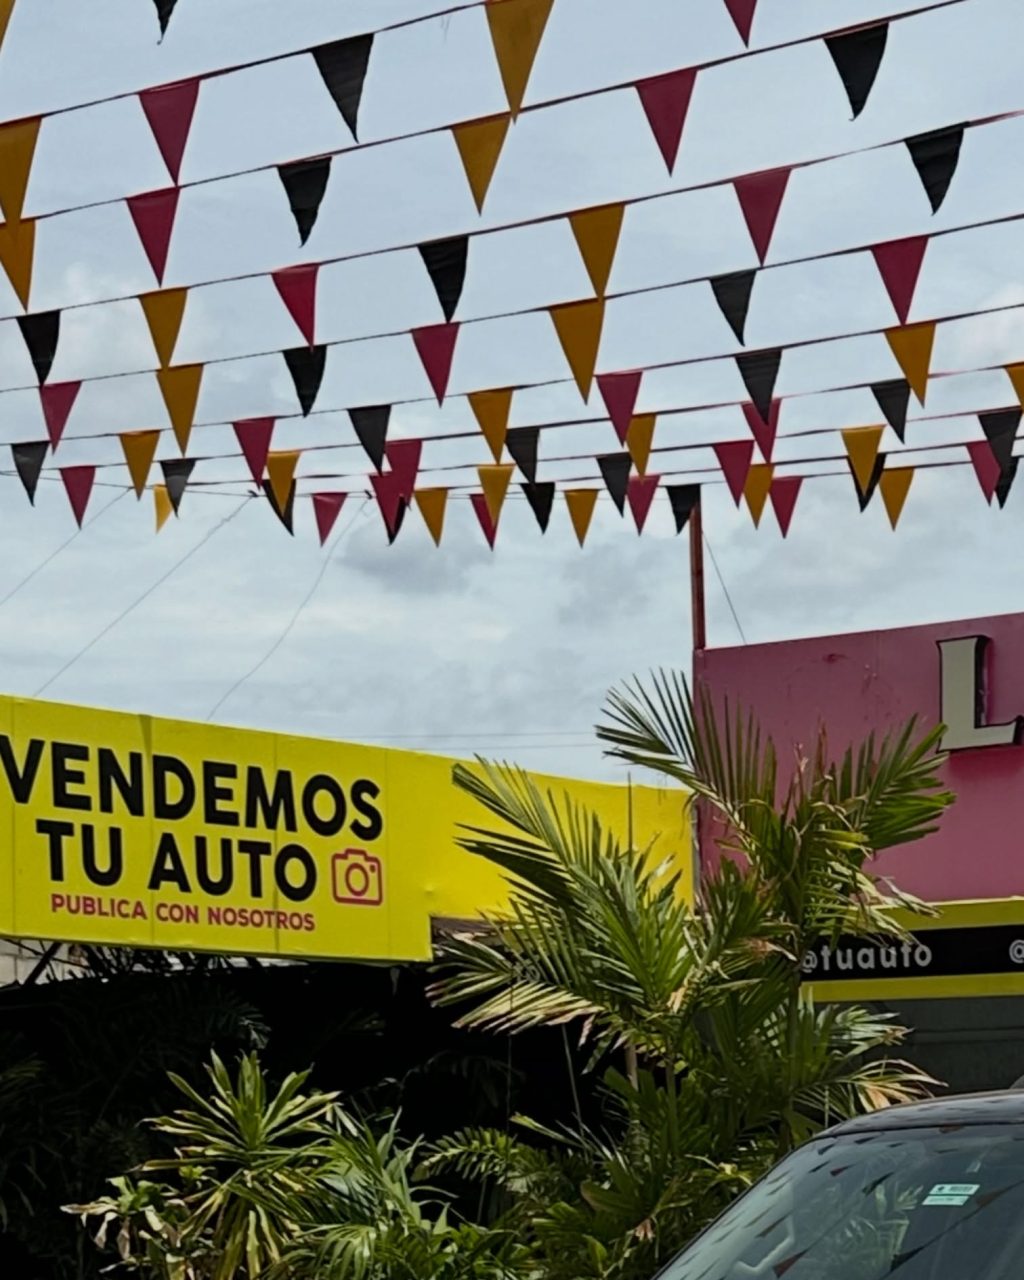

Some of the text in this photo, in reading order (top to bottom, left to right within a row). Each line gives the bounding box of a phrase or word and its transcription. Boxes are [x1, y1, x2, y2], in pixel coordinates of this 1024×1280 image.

[0, 734, 383, 840] VENDEMOS
[36, 818, 317, 902] TU AUTO
[51, 894, 315, 931] PUBLICA CON NOSOTROS
[802, 943, 933, 973] @tuauto
